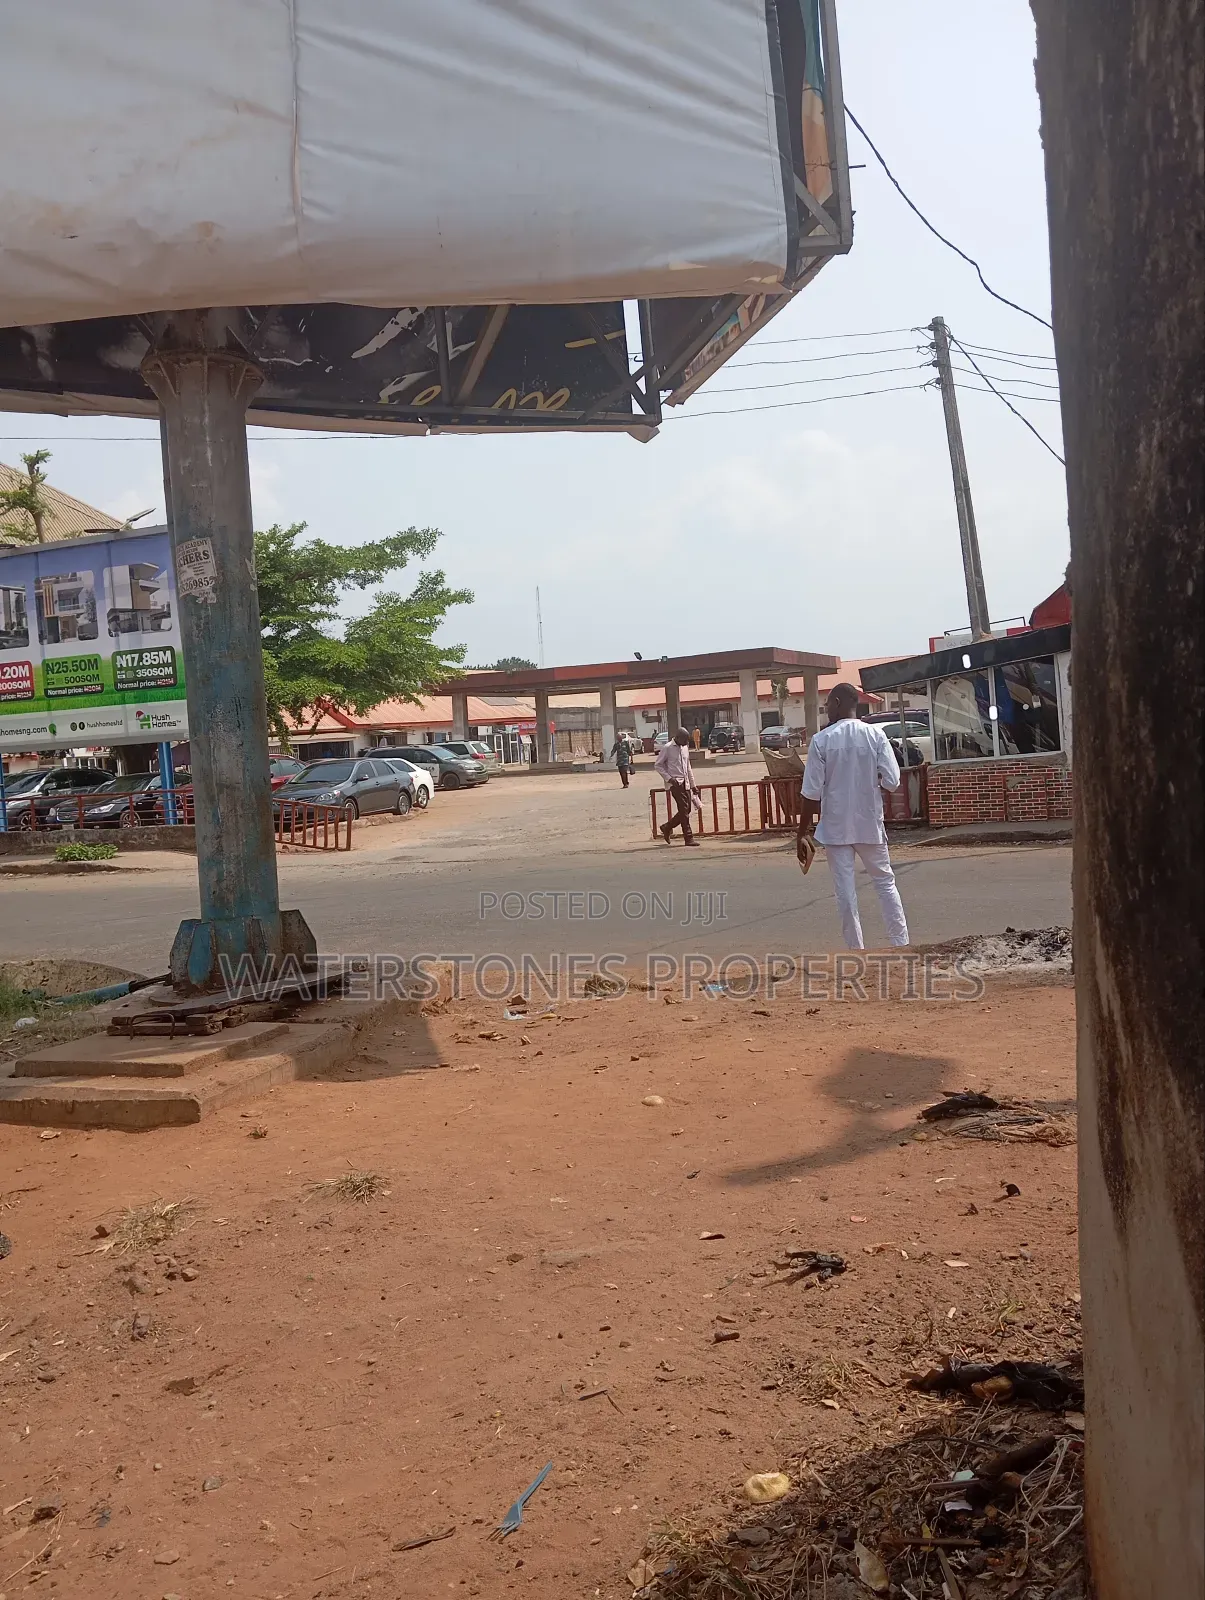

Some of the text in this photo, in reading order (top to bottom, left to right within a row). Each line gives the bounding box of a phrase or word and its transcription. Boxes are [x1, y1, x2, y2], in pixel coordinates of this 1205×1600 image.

[0, 664, 30, 680] .20M
[136, 666, 173, 677] 350SQM
[64, 673, 100, 685] 500SQM
[117, 681, 139, 689] Normal
[47, 688, 67, 696] Normal
